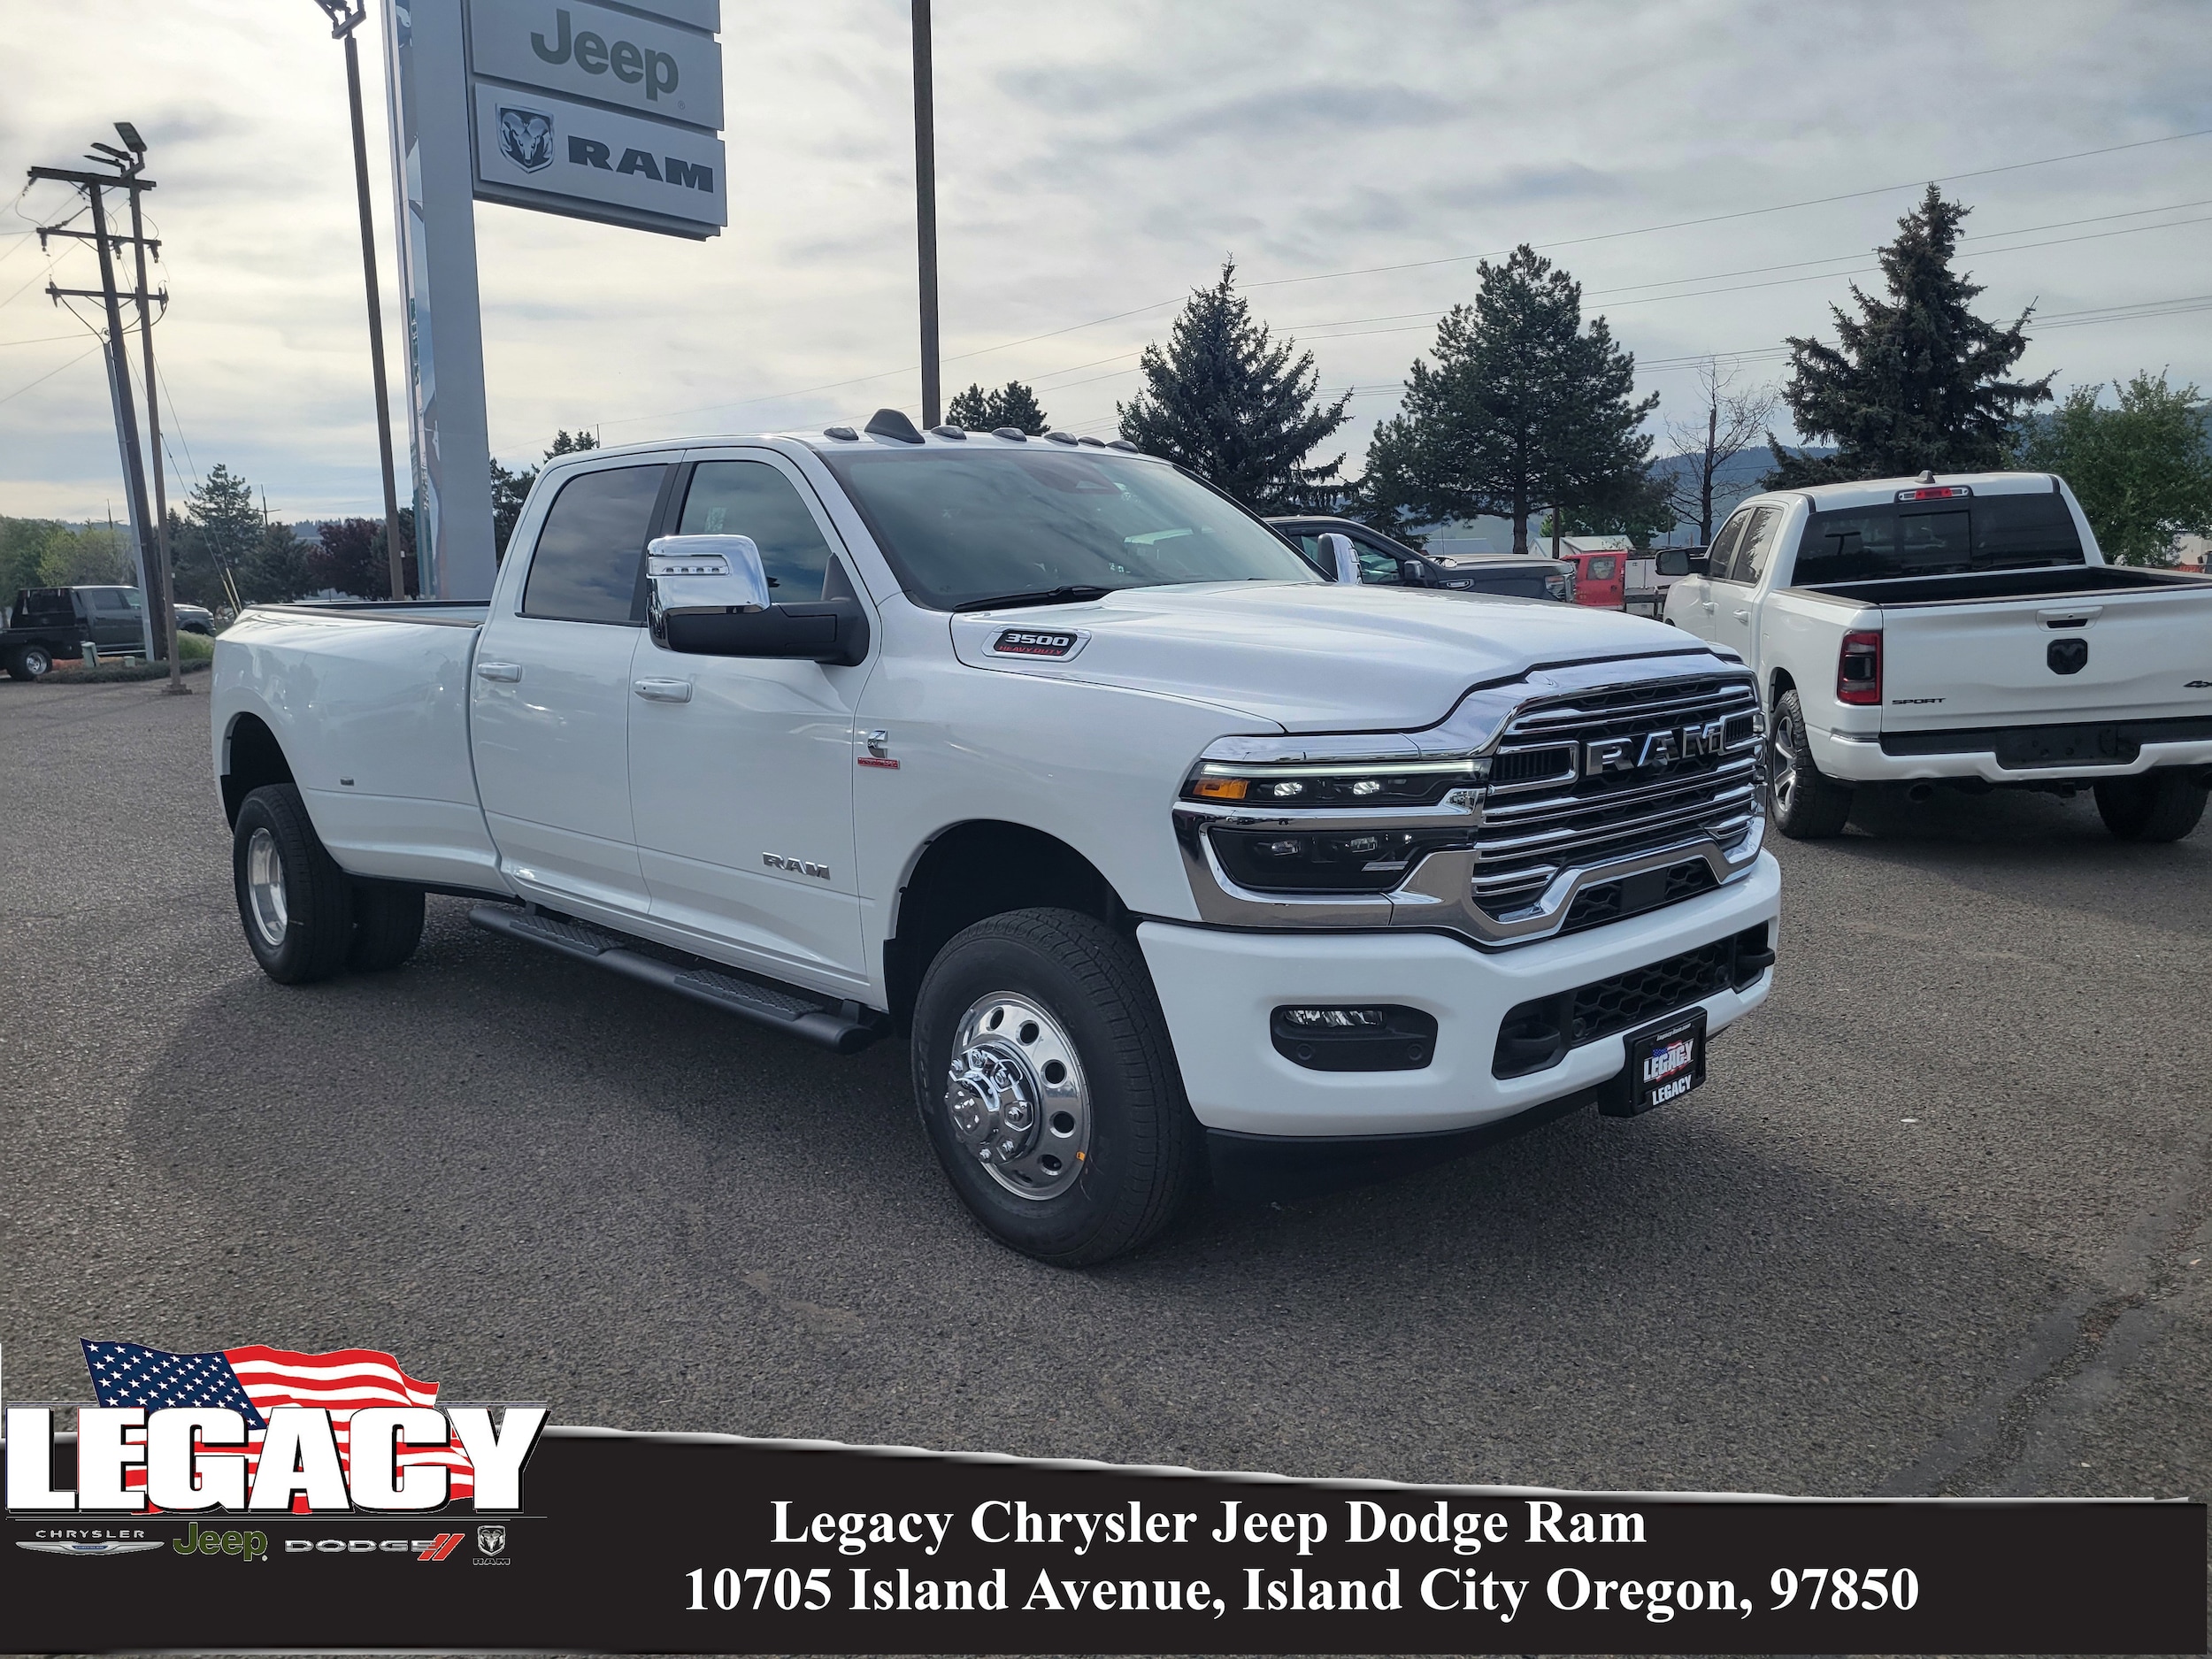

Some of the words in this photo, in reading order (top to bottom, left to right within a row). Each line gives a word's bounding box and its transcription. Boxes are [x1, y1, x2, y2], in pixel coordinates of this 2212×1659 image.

[531, 9, 680, 101] Jeep
[568, 135, 714, 194] RAM
[1005, 633, 1070, 647] 3500
[1586, 721, 1724, 776] RAM
[762, 851, 831, 880] RAM
[1643, 1039, 1694, 1081] LEGACY
[1651, 1074, 1692, 1106] LEGACY
